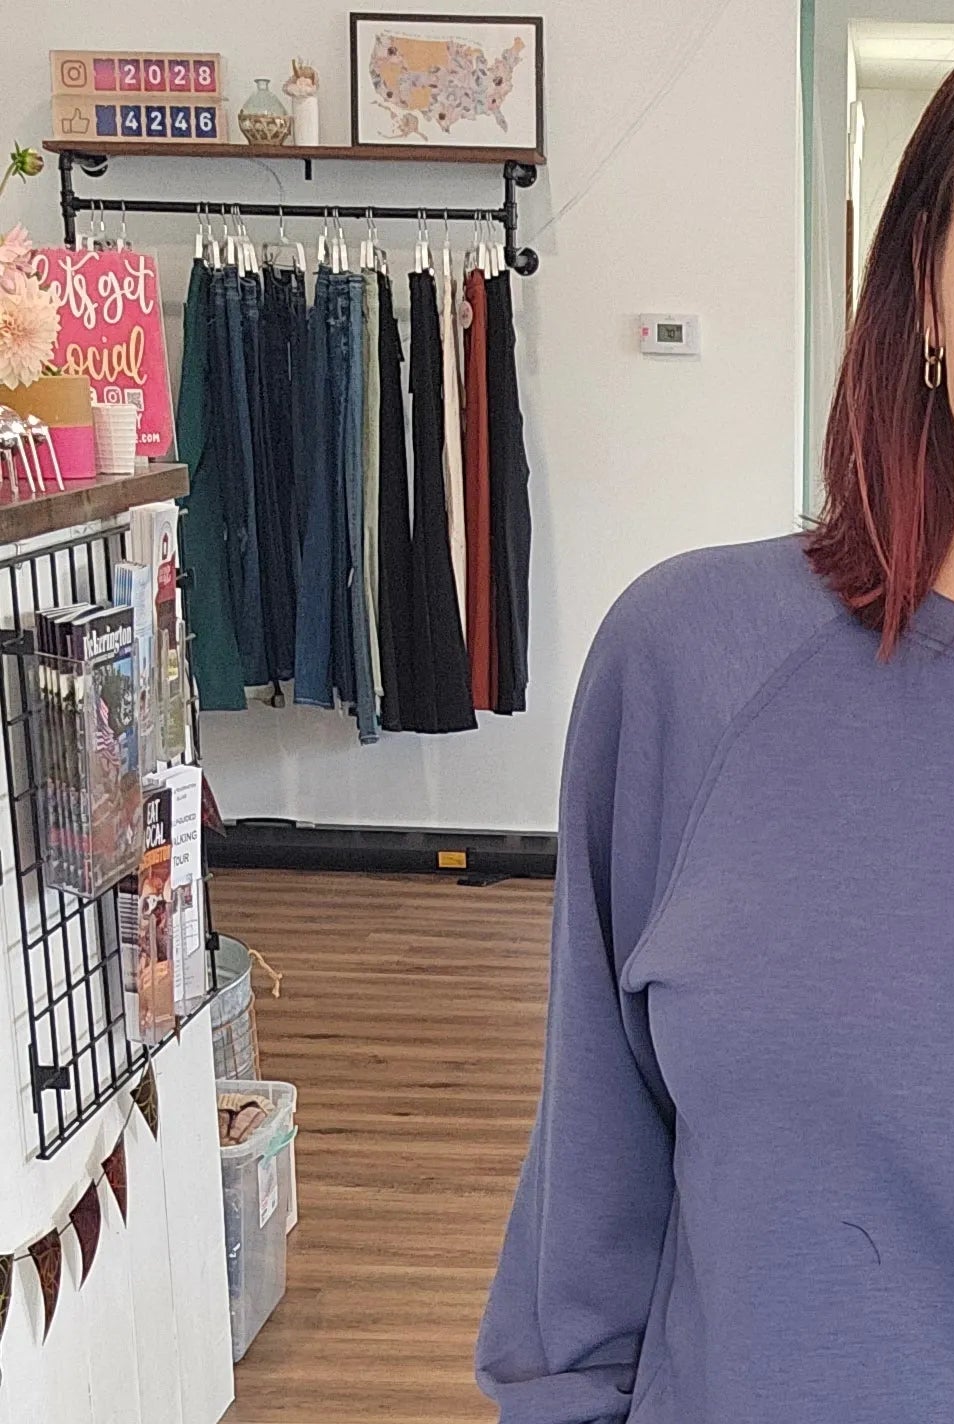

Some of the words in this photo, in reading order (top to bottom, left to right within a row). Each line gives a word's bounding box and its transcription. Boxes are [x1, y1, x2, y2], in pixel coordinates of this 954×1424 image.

[123, 64, 211, 85] 2028
[125, 111, 213, 131] 4246
[98, 254, 154, 324] get
[56, 326, 148, 385] ocial
[147, 799, 161, 826] EAT
[146, 822, 167, 849] OCAL
[173, 853, 190, 868] TOUR
